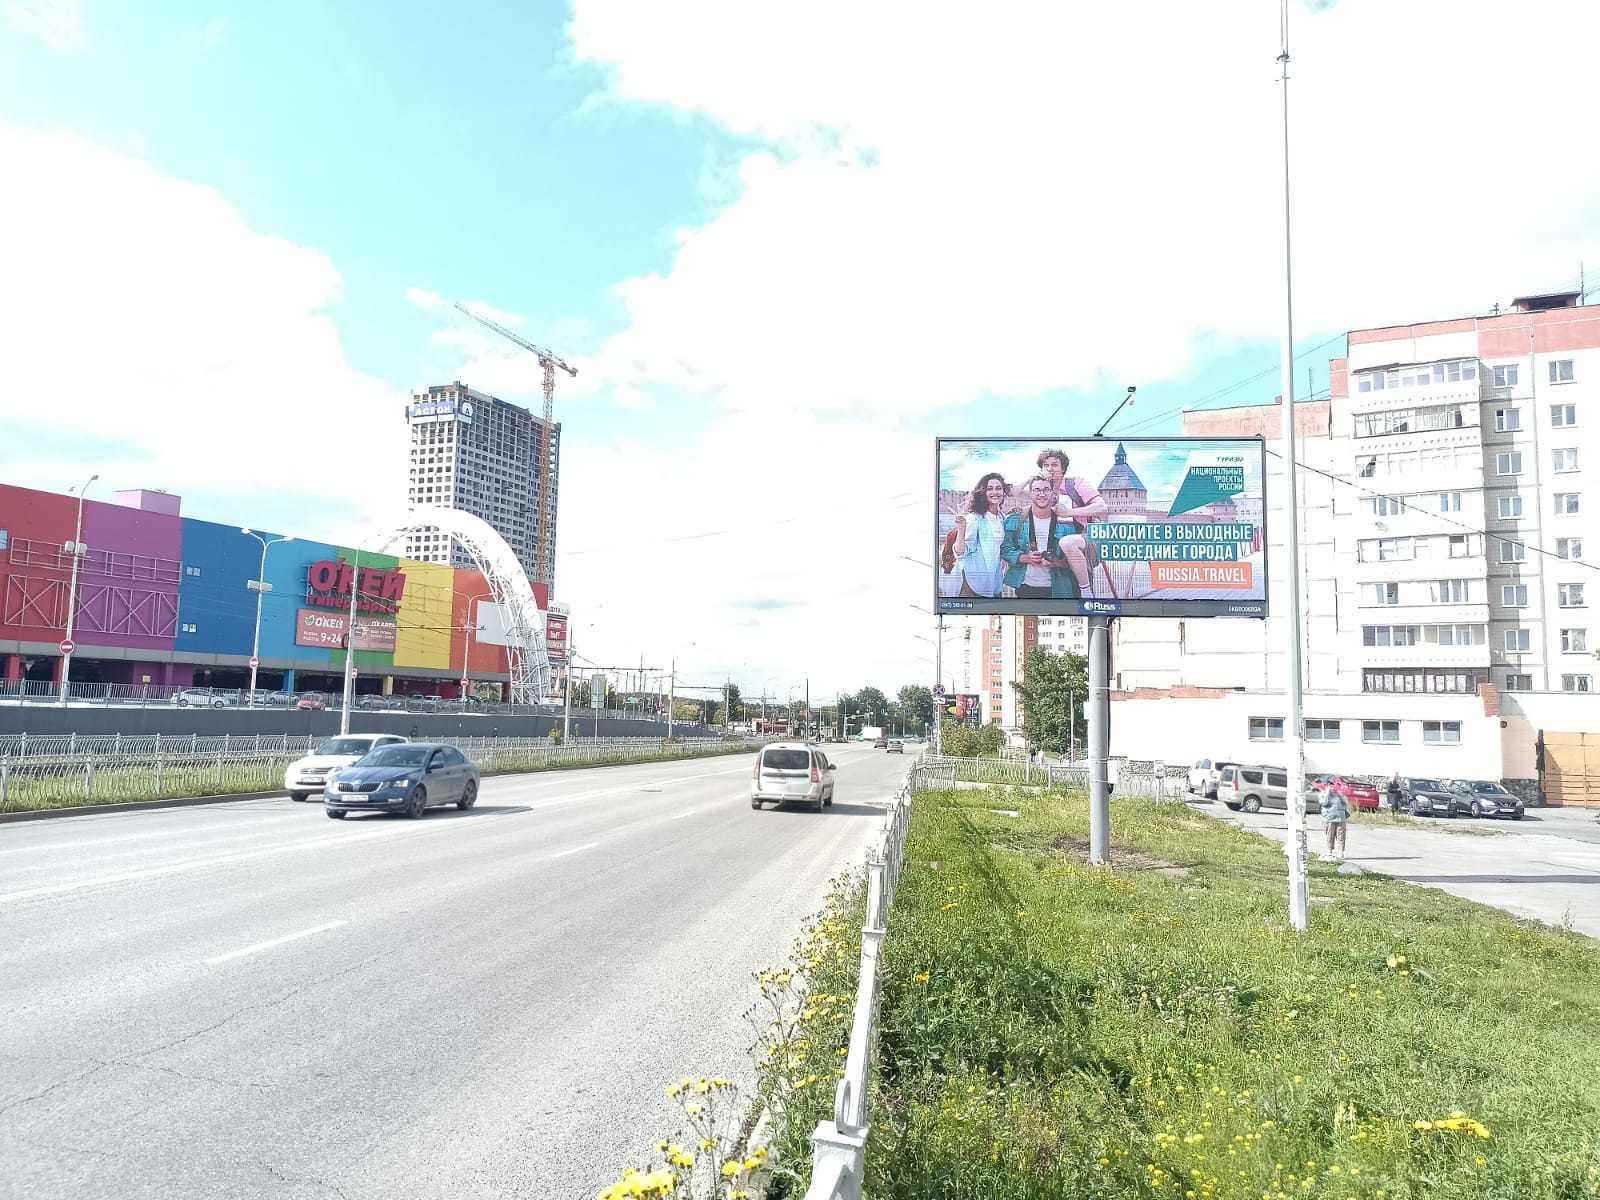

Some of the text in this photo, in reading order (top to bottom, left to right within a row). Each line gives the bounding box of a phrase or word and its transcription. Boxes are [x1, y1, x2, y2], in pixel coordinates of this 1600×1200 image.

[1190, 467, 1243, 476] НАЦИОНАЛЬНЫЕ
[1213, 475, 1243, 484] ПРОЕКТЫ
[1218, 483, 1243, 491] РОССИИ
[1090, 525, 1252, 541] ВЫХОДИТЕ В ВЫХОДНЫЕ
[1101, 544, 1233, 560] В СОСЕДНИЕ ГОРОДА
[1158, 567, 1247, 583] RUSSIA.TRAVEL
